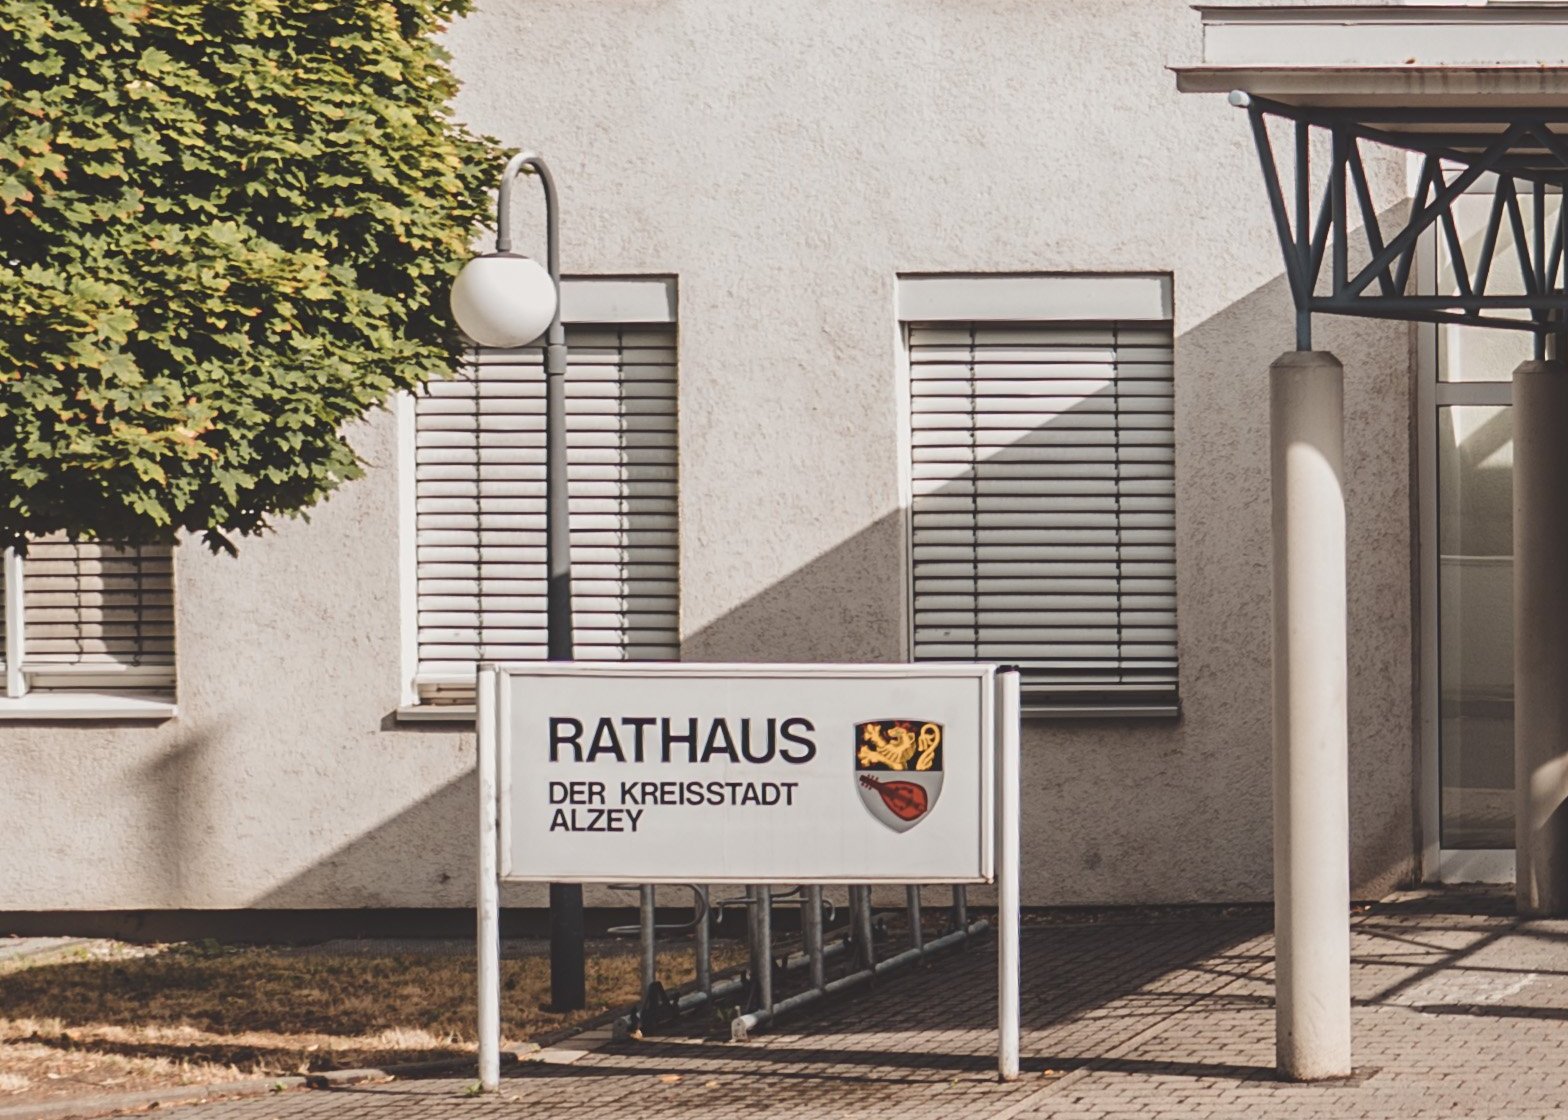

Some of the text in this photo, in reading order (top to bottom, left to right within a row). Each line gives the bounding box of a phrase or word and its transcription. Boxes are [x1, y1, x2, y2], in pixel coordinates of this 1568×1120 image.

[550, 717, 816, 763] RATHAUS
[549, 782, 799, 806] DER KREISSTADT
[550, 809, 644, 833] ALZEY
